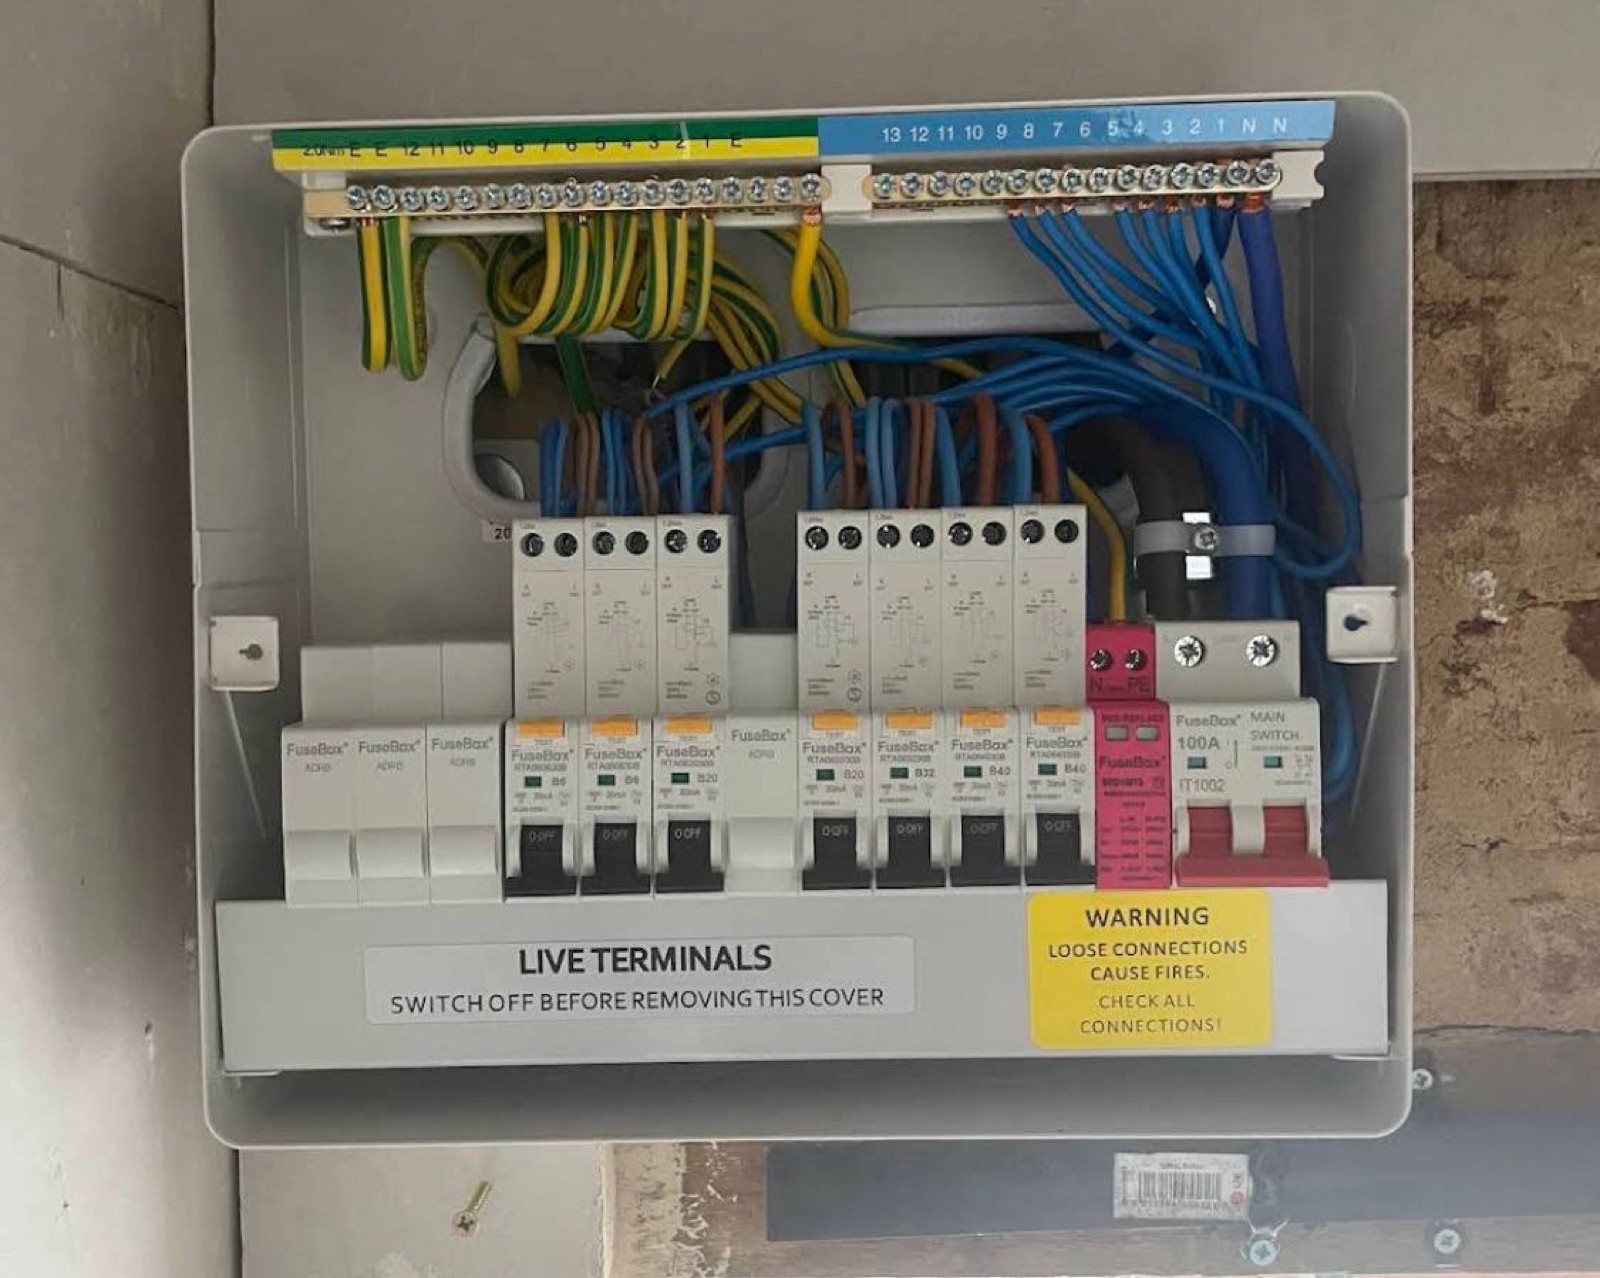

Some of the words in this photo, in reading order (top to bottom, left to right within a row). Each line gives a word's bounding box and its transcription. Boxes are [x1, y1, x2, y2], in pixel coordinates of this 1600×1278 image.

[882, 127, 902, 143] 13
[910, 126, 930, 142] 12
[938, 125, 954, 141] 11
[965, 124, 984, 140] 10
[996, 124, 1008, 139] 9
[1023, 122, 1035, 139] 8
[1053, 121, 1064, 137] 7
[1079, 121, 1092, 137] 6
[1108, 120, 1118, 136] 5
[1133, 120, 1144, 135] 4
[1162, 119, 1173, 135] 3
[1189, 118, 1201, 135] 2
[1217, 118, 1224, 134] 1
[1242, 118, 1256, 133] N
[1273, 117, 1288, 132] N
[350, 142, 362, 157] E
[375, 141, 388, 156] E
[403, 141, 420, 156] 12
[431, 141, 444, 156] 11
[457, 140, 474, 155] 10
[487, 139, 498, 154] 9
[541, 138, 550, 153] 7
[566, 137, 577, 152] 6
[621, 137, 632, 150] 4
[675, 136, 686, 150] 2
[730, 133, 743, 148] E
[1176, 714, 1238, 727] FuseBox
[1250, 711, 1285, 722] MAIN
[731, 729, 788, 741] FuseBox
[1250, 730, 1299, 741] SWITCH
[287, 743, 345, 756] FuseBox
[359, 740, 418, 754] FuseBox
[431, 737, 491, 751] FuseBox
[803, 742, 862, 754] FuseBox
[878, 741, 935, 752] FuseBox
[951, 739, 1008, 750] FuseBox
[1027, 737, 1084, 749] FuseBox
[1178, 737, 1220, 750] 100A
[511, 749, 570, 761] FuseBox
[585, 748, 643, 760] FuseBox
[657, 745, 716, 758] FuseBox
[844, 769, 865, 780] B20
[914, 768, 935, 777] B32
[989, 765, 1011, 776] B40
[1064, 763, 1087, 774] B40
[697, 773, 718, 783] B20
[1179, 778, 1225, 792] IT1002
[1086, 906, 1209, 928] WARNING
[1049, 943, 1108, 958] LOOSE
[1113, 939, 1248, 957] CONNECTIONS
[519, 948, 586, 975] LIVE
[590, 944, 772, 973] TERMINALS
[1090, 966, 1150, 981] CAUSE
[1155, 964, 1210, 980] FIRES.
[391, 994, 483, 1014] SWITCH
[488, 993, 534, 1012] OFF
[541, 991, 628, 1011] BEFORE
[633, 989, 752, 1009] REMOVING
[754, 988, 806, 1008] THIS
[808, 987, 884, 1007] COVER
[1099, 995, 1159, 1009] CHECK
[1164, 994, 1196, 1008] ALL
[1080, 1017, 1221, 1034] CONNECTIONS!
